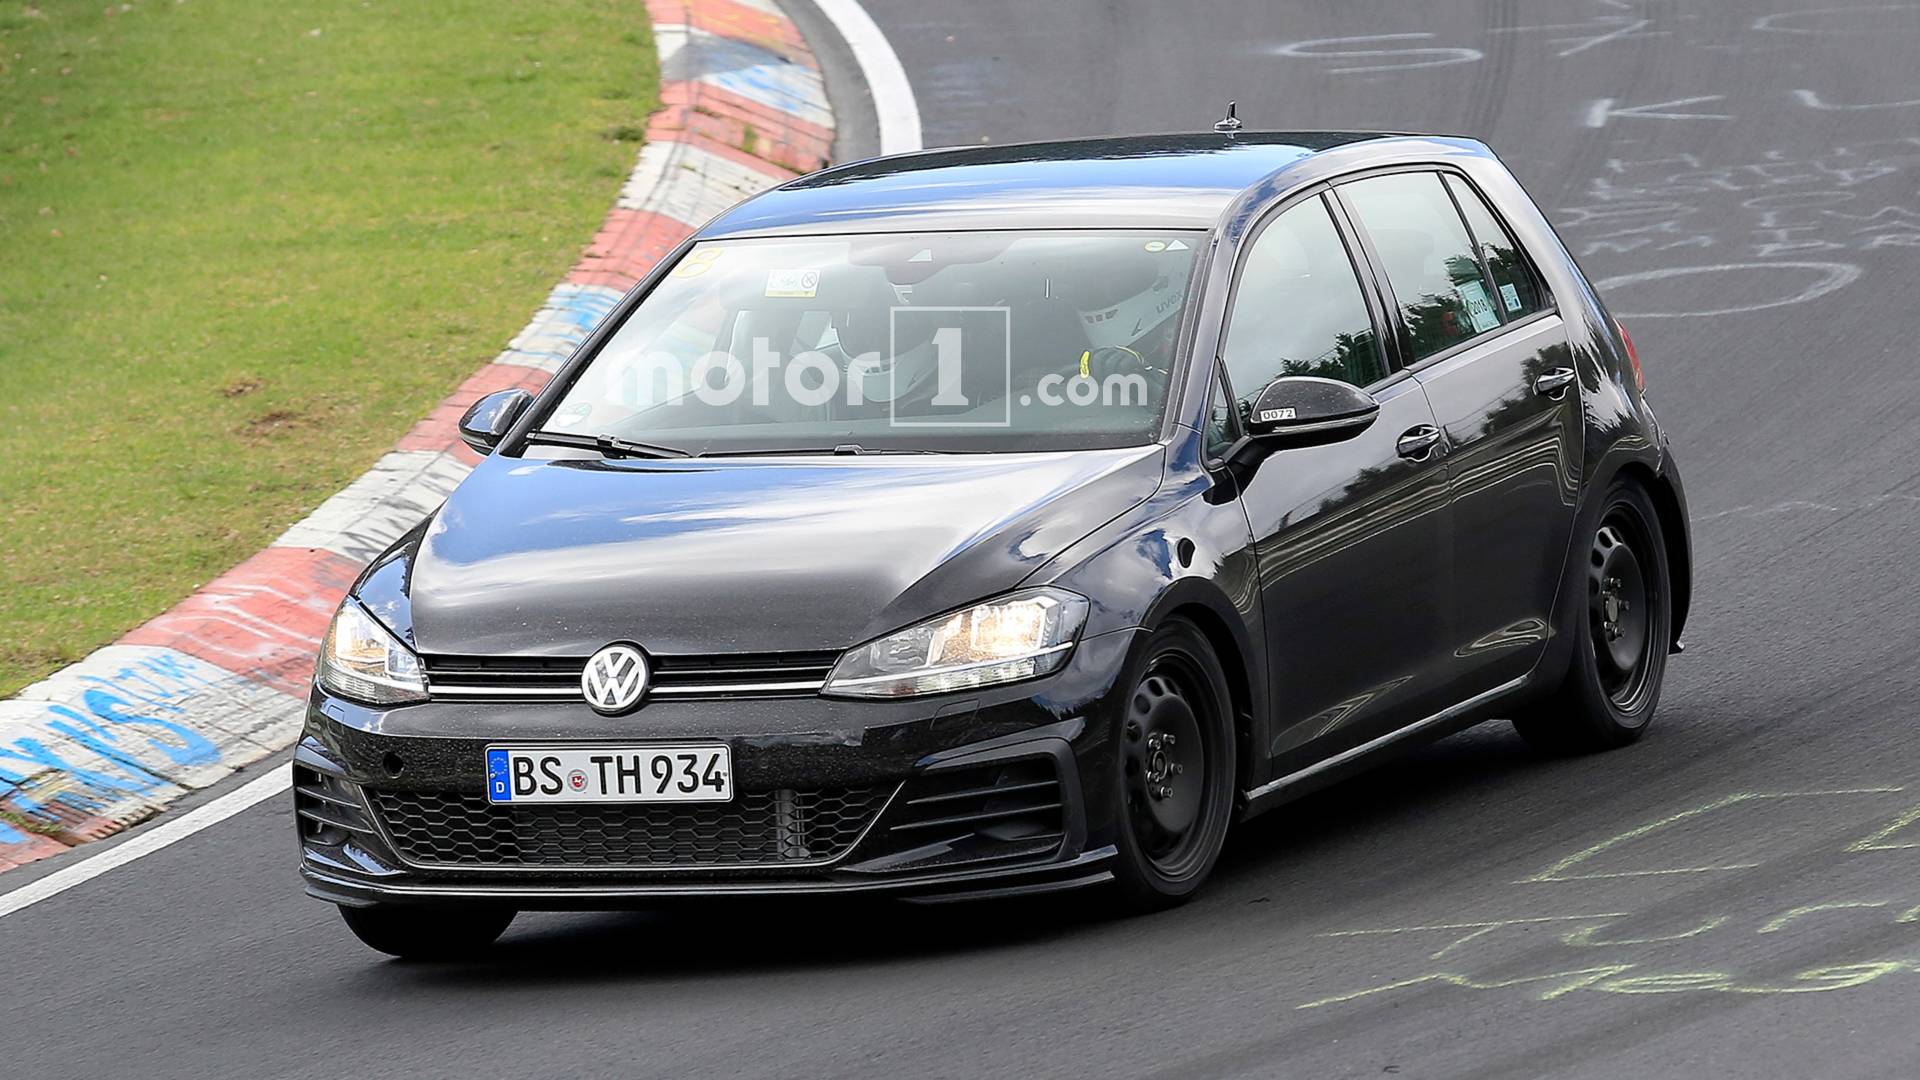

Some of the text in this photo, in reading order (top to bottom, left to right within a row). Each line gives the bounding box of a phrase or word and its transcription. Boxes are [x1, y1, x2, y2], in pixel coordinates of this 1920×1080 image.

[1263, 409, 1294, 420] 0072
[513, 757, 563, 796] BS
[495, 781, 505, 794] D
